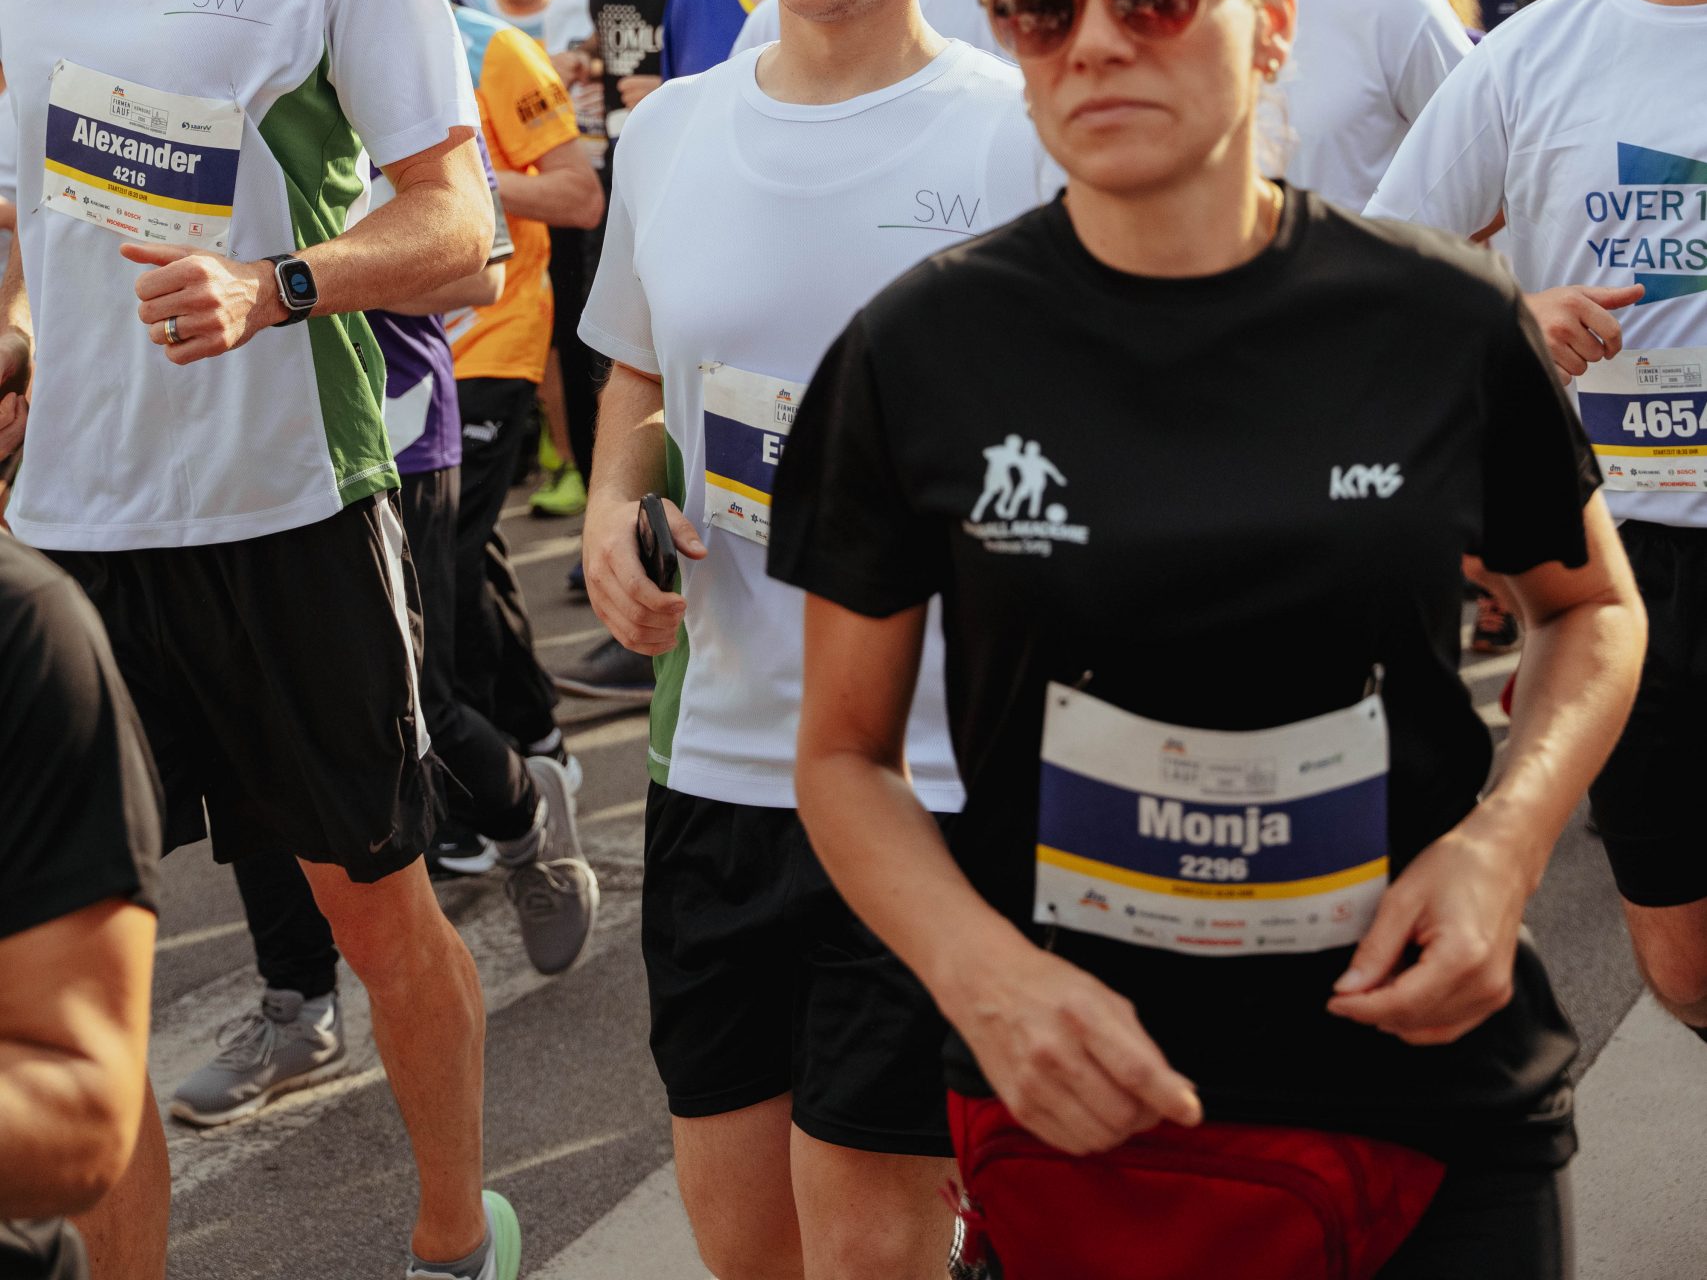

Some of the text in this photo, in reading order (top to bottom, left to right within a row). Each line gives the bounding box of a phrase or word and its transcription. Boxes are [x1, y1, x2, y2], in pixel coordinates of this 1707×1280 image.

[112, 98, 131, 109] FIRMEN
[112, 105, 130, 116] LAUF
[72, 117, 202, 174] Alexander
[112, 165, 147, 187] 4216
[123, 210, 142, 221] BOSCH
[913, 189, 981, 229] SW
[1584, 190, 1685, 223] OVER
[1586, 237, 1707, 271] YEARS
[1639, 375, 1659, 384] LAUF
[776, 411, 793, 424] LAU
[1137, 794, 1292, 855] Monja
[1179, 854, 1249, 881] 2296
